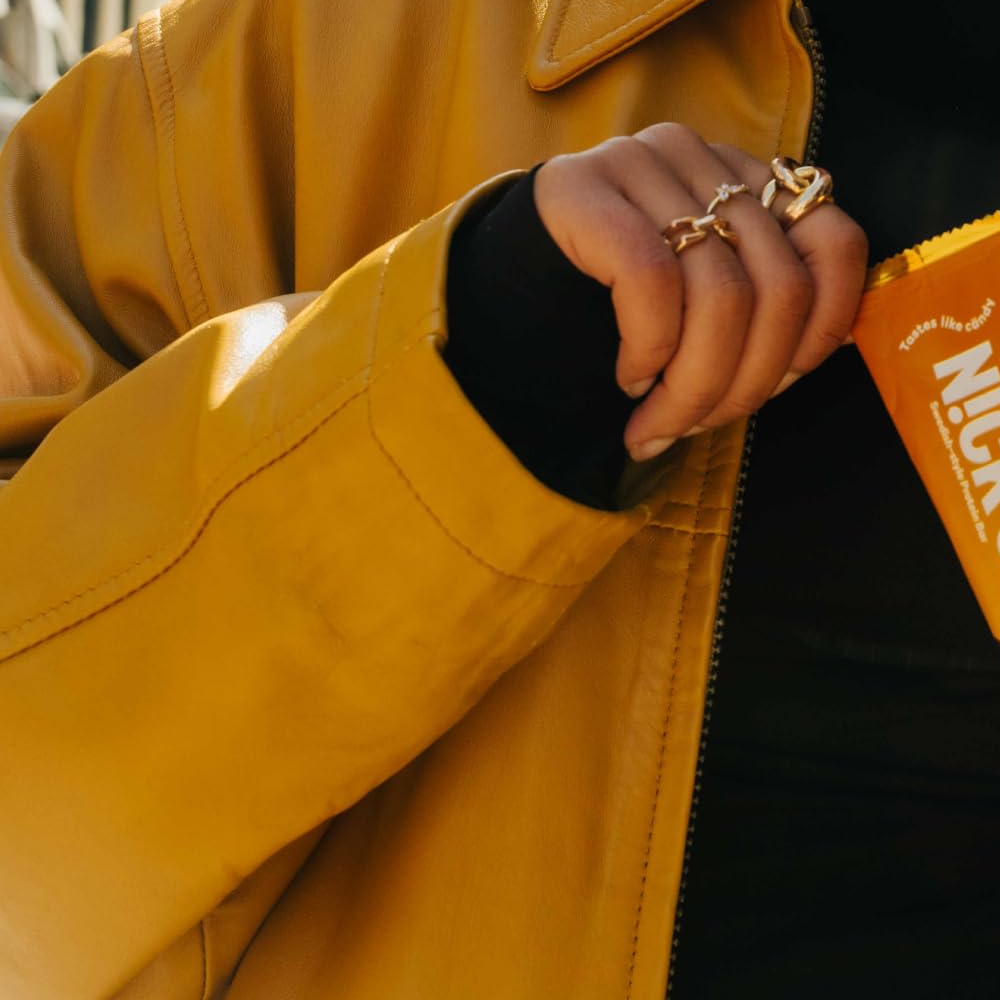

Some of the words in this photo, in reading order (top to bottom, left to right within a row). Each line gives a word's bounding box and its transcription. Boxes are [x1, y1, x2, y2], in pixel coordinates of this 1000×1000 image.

[899, 318, 937, 351] Tastes
[941, 314, 963, 332] like
[930, 400, 965, 480] Swedish-style
[960, 480, 980, 521] Protein
[976, 521, 988, 543] Bar
